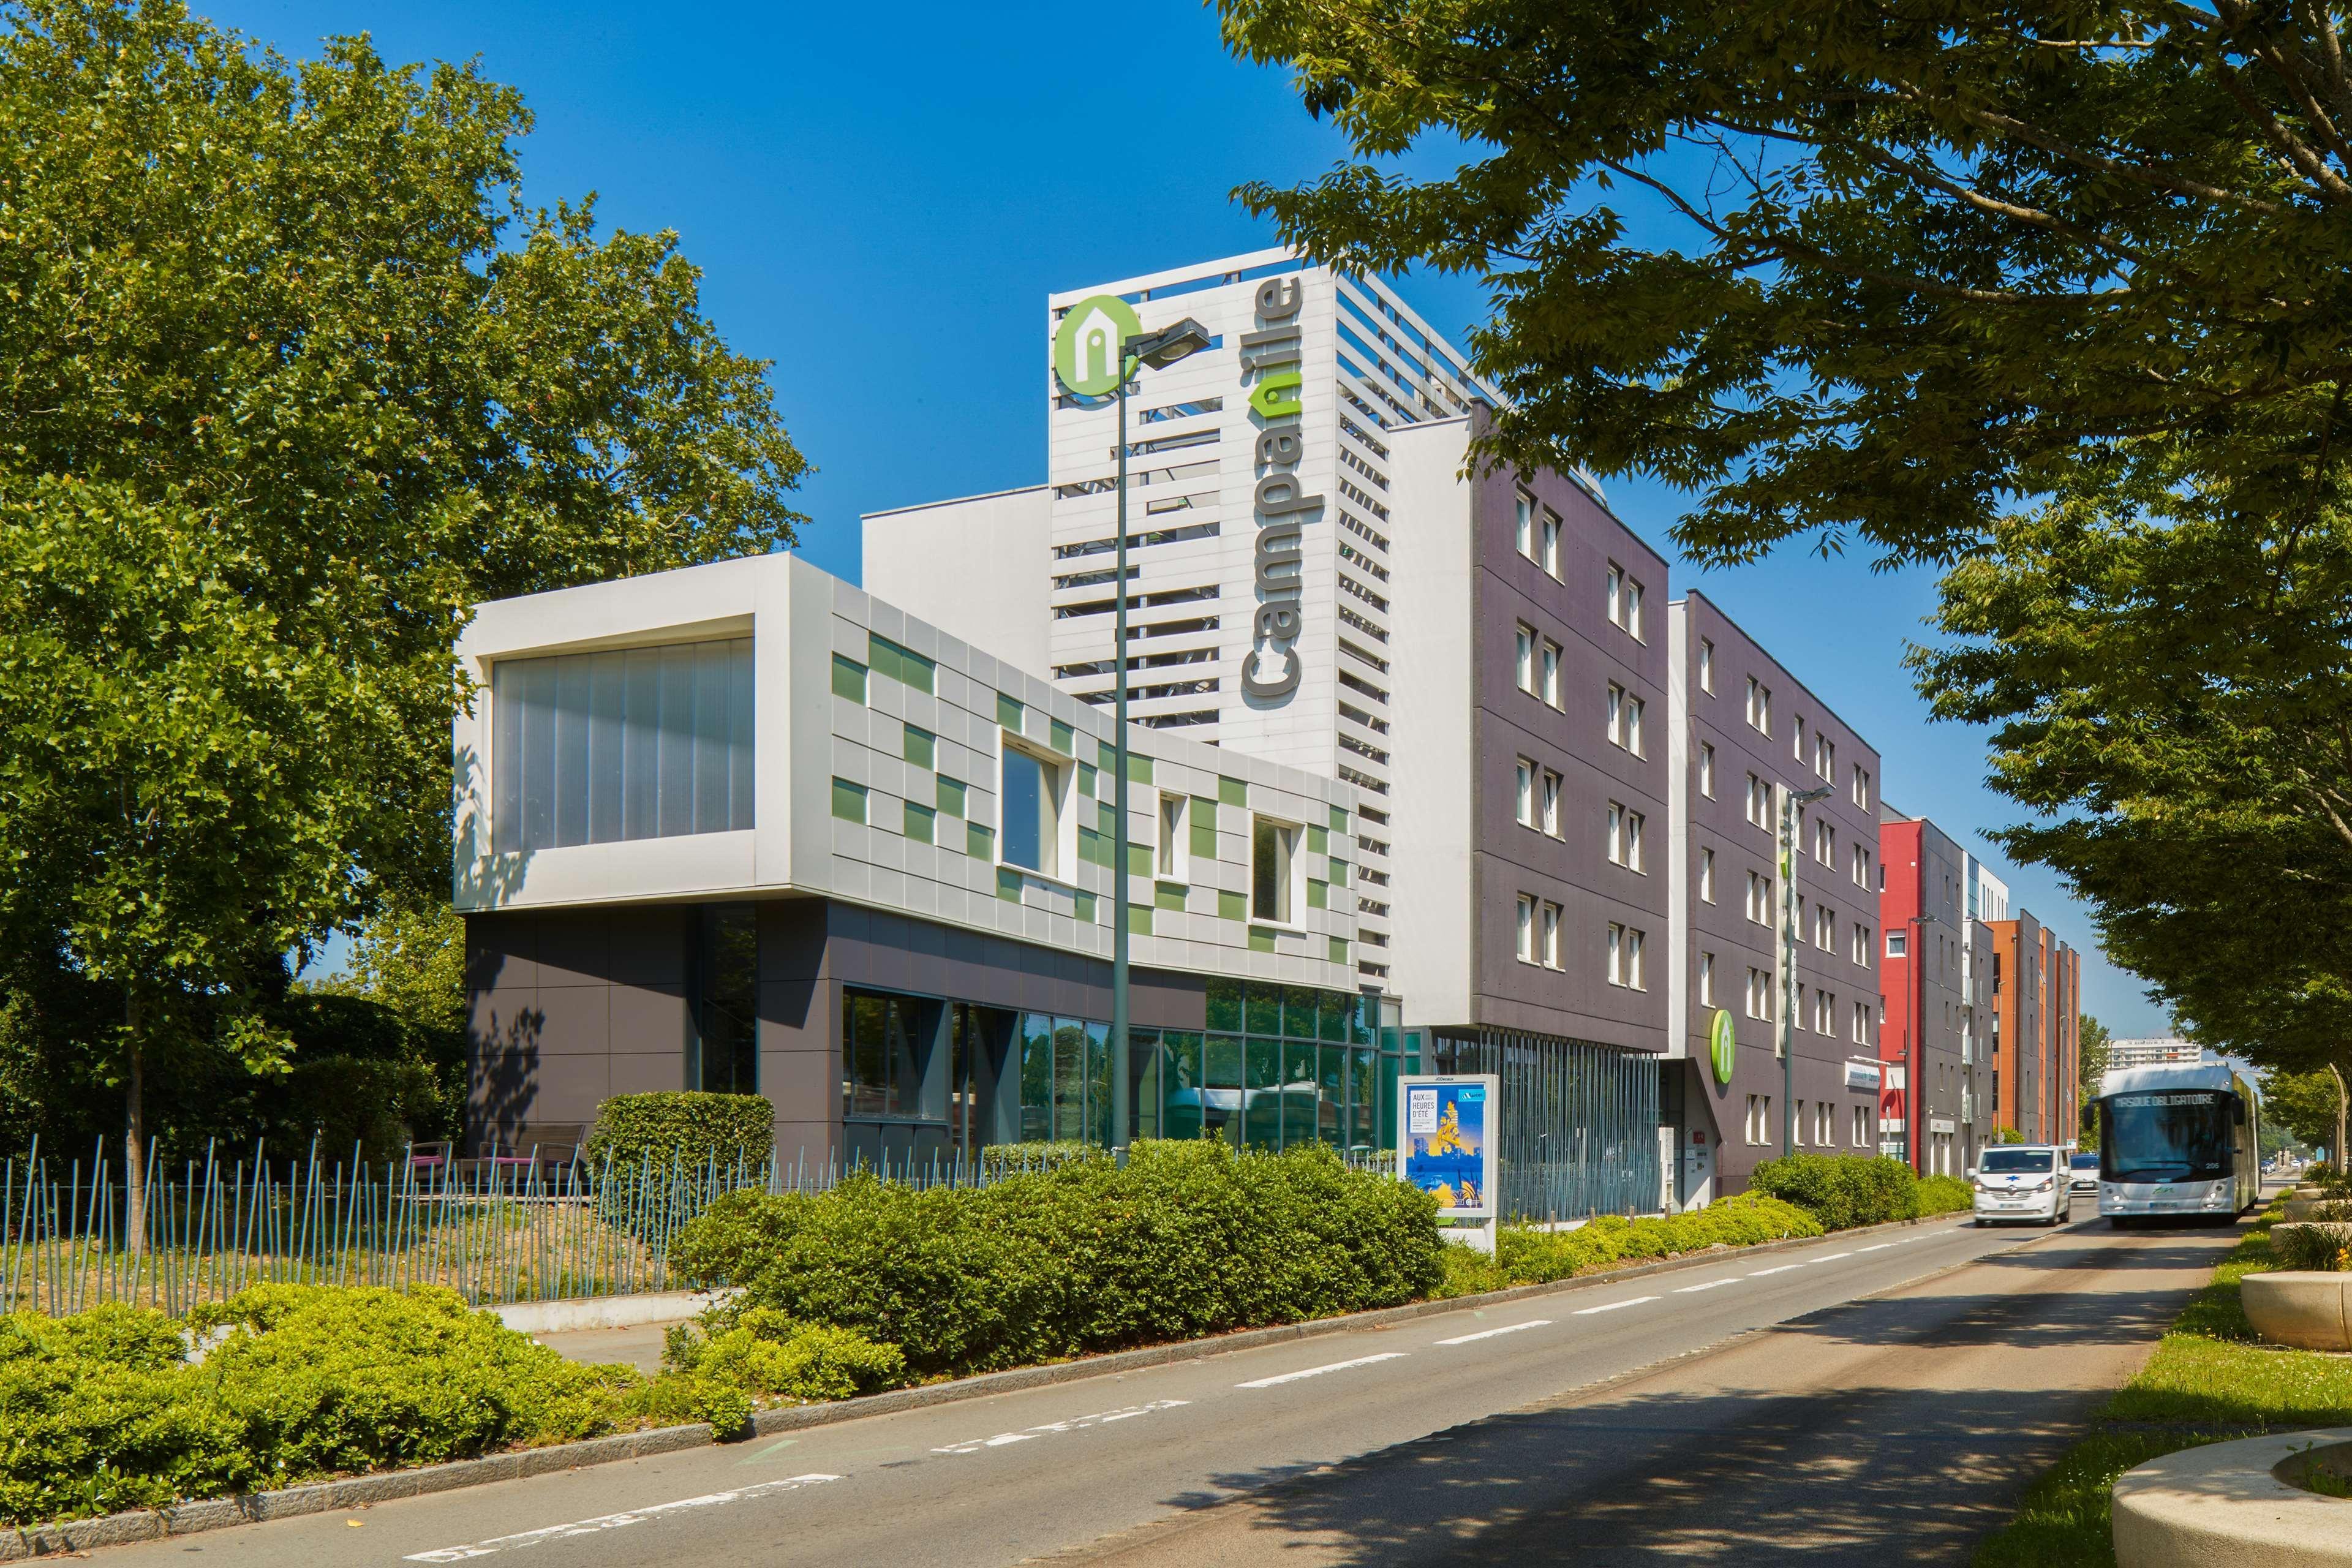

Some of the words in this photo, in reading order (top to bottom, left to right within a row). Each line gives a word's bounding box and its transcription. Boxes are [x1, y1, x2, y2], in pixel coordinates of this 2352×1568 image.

[1240, 276, 1325, 696] Campanile
[2115, 1096, 2151, 1107] MASQUE
[2152, 1094, 2214, 1106] OBLIGATOIRE
